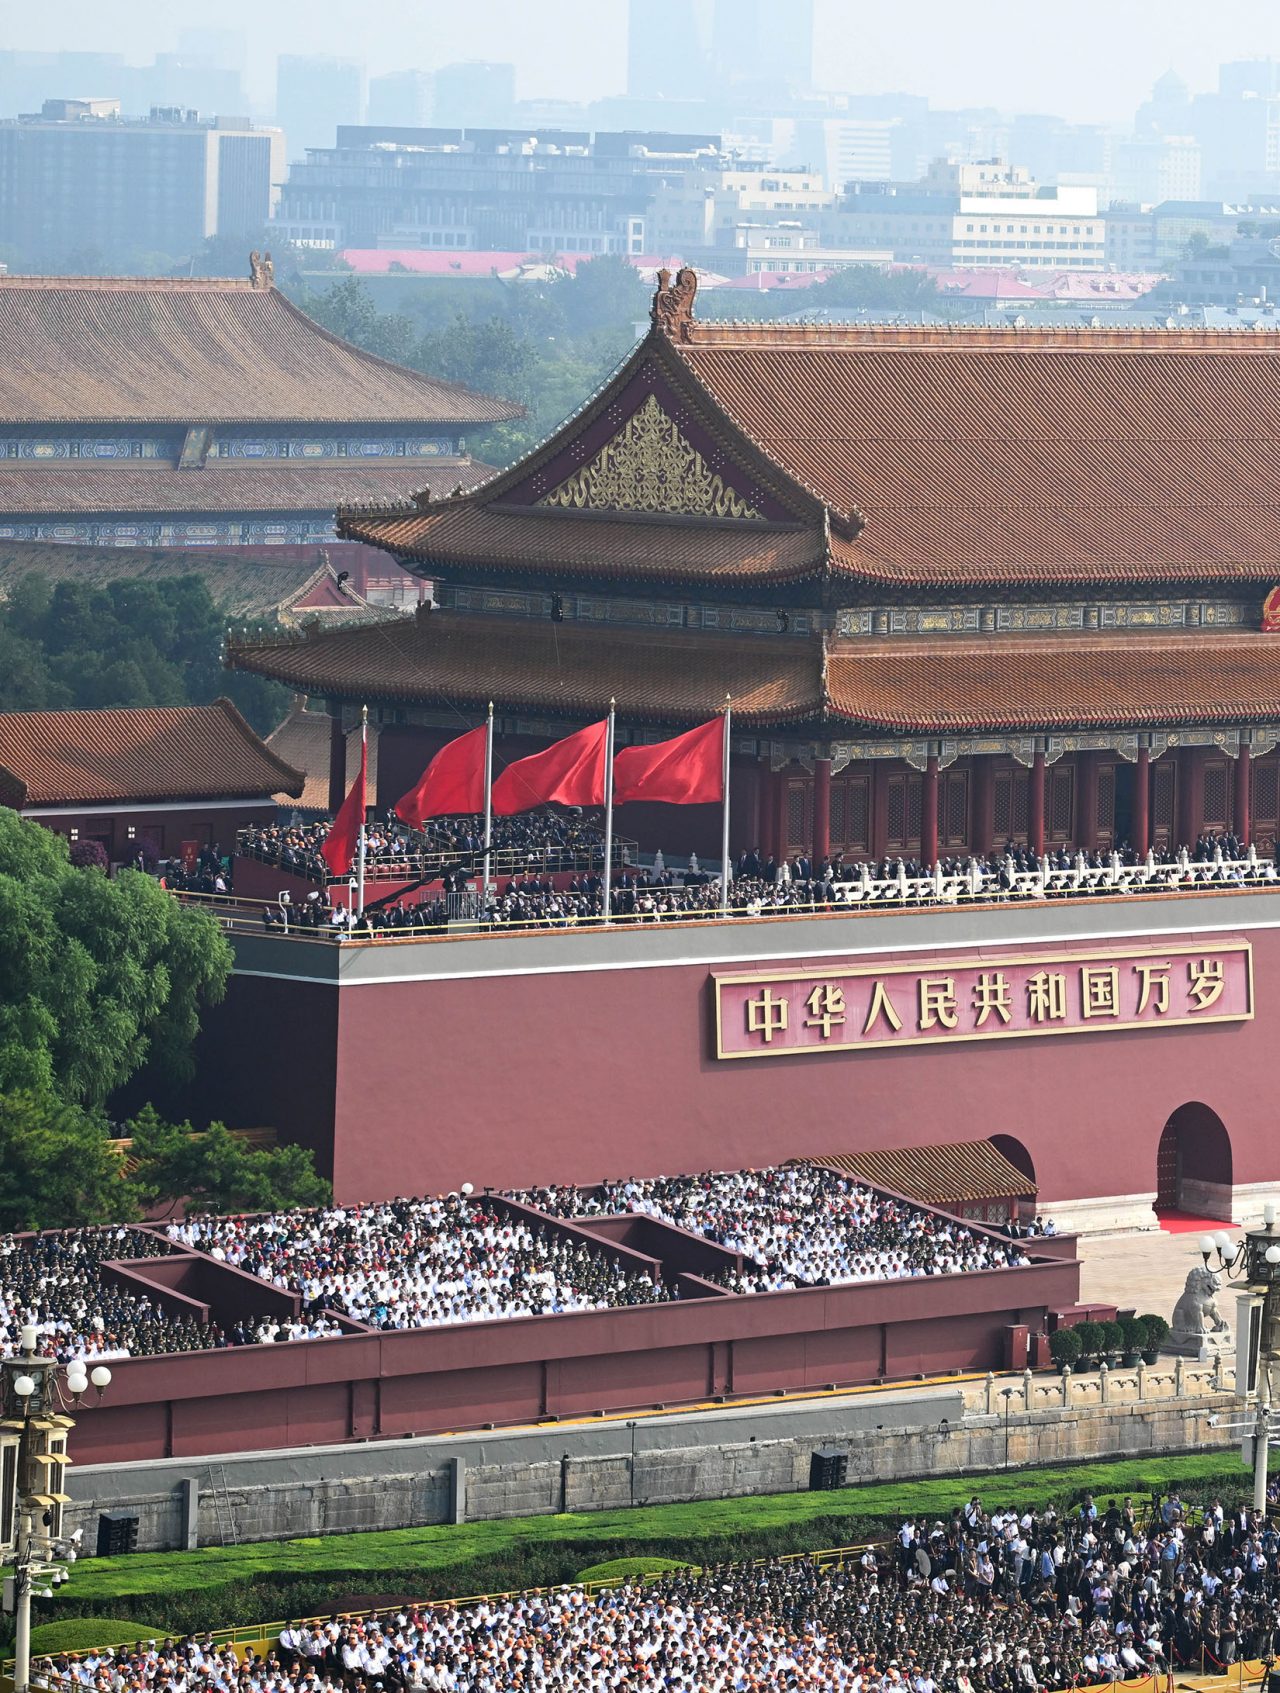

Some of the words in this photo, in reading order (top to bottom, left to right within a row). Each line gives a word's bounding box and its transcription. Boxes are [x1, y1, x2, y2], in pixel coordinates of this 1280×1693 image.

[747, 959, 1225, 1042] 中华人民共和国万岁
